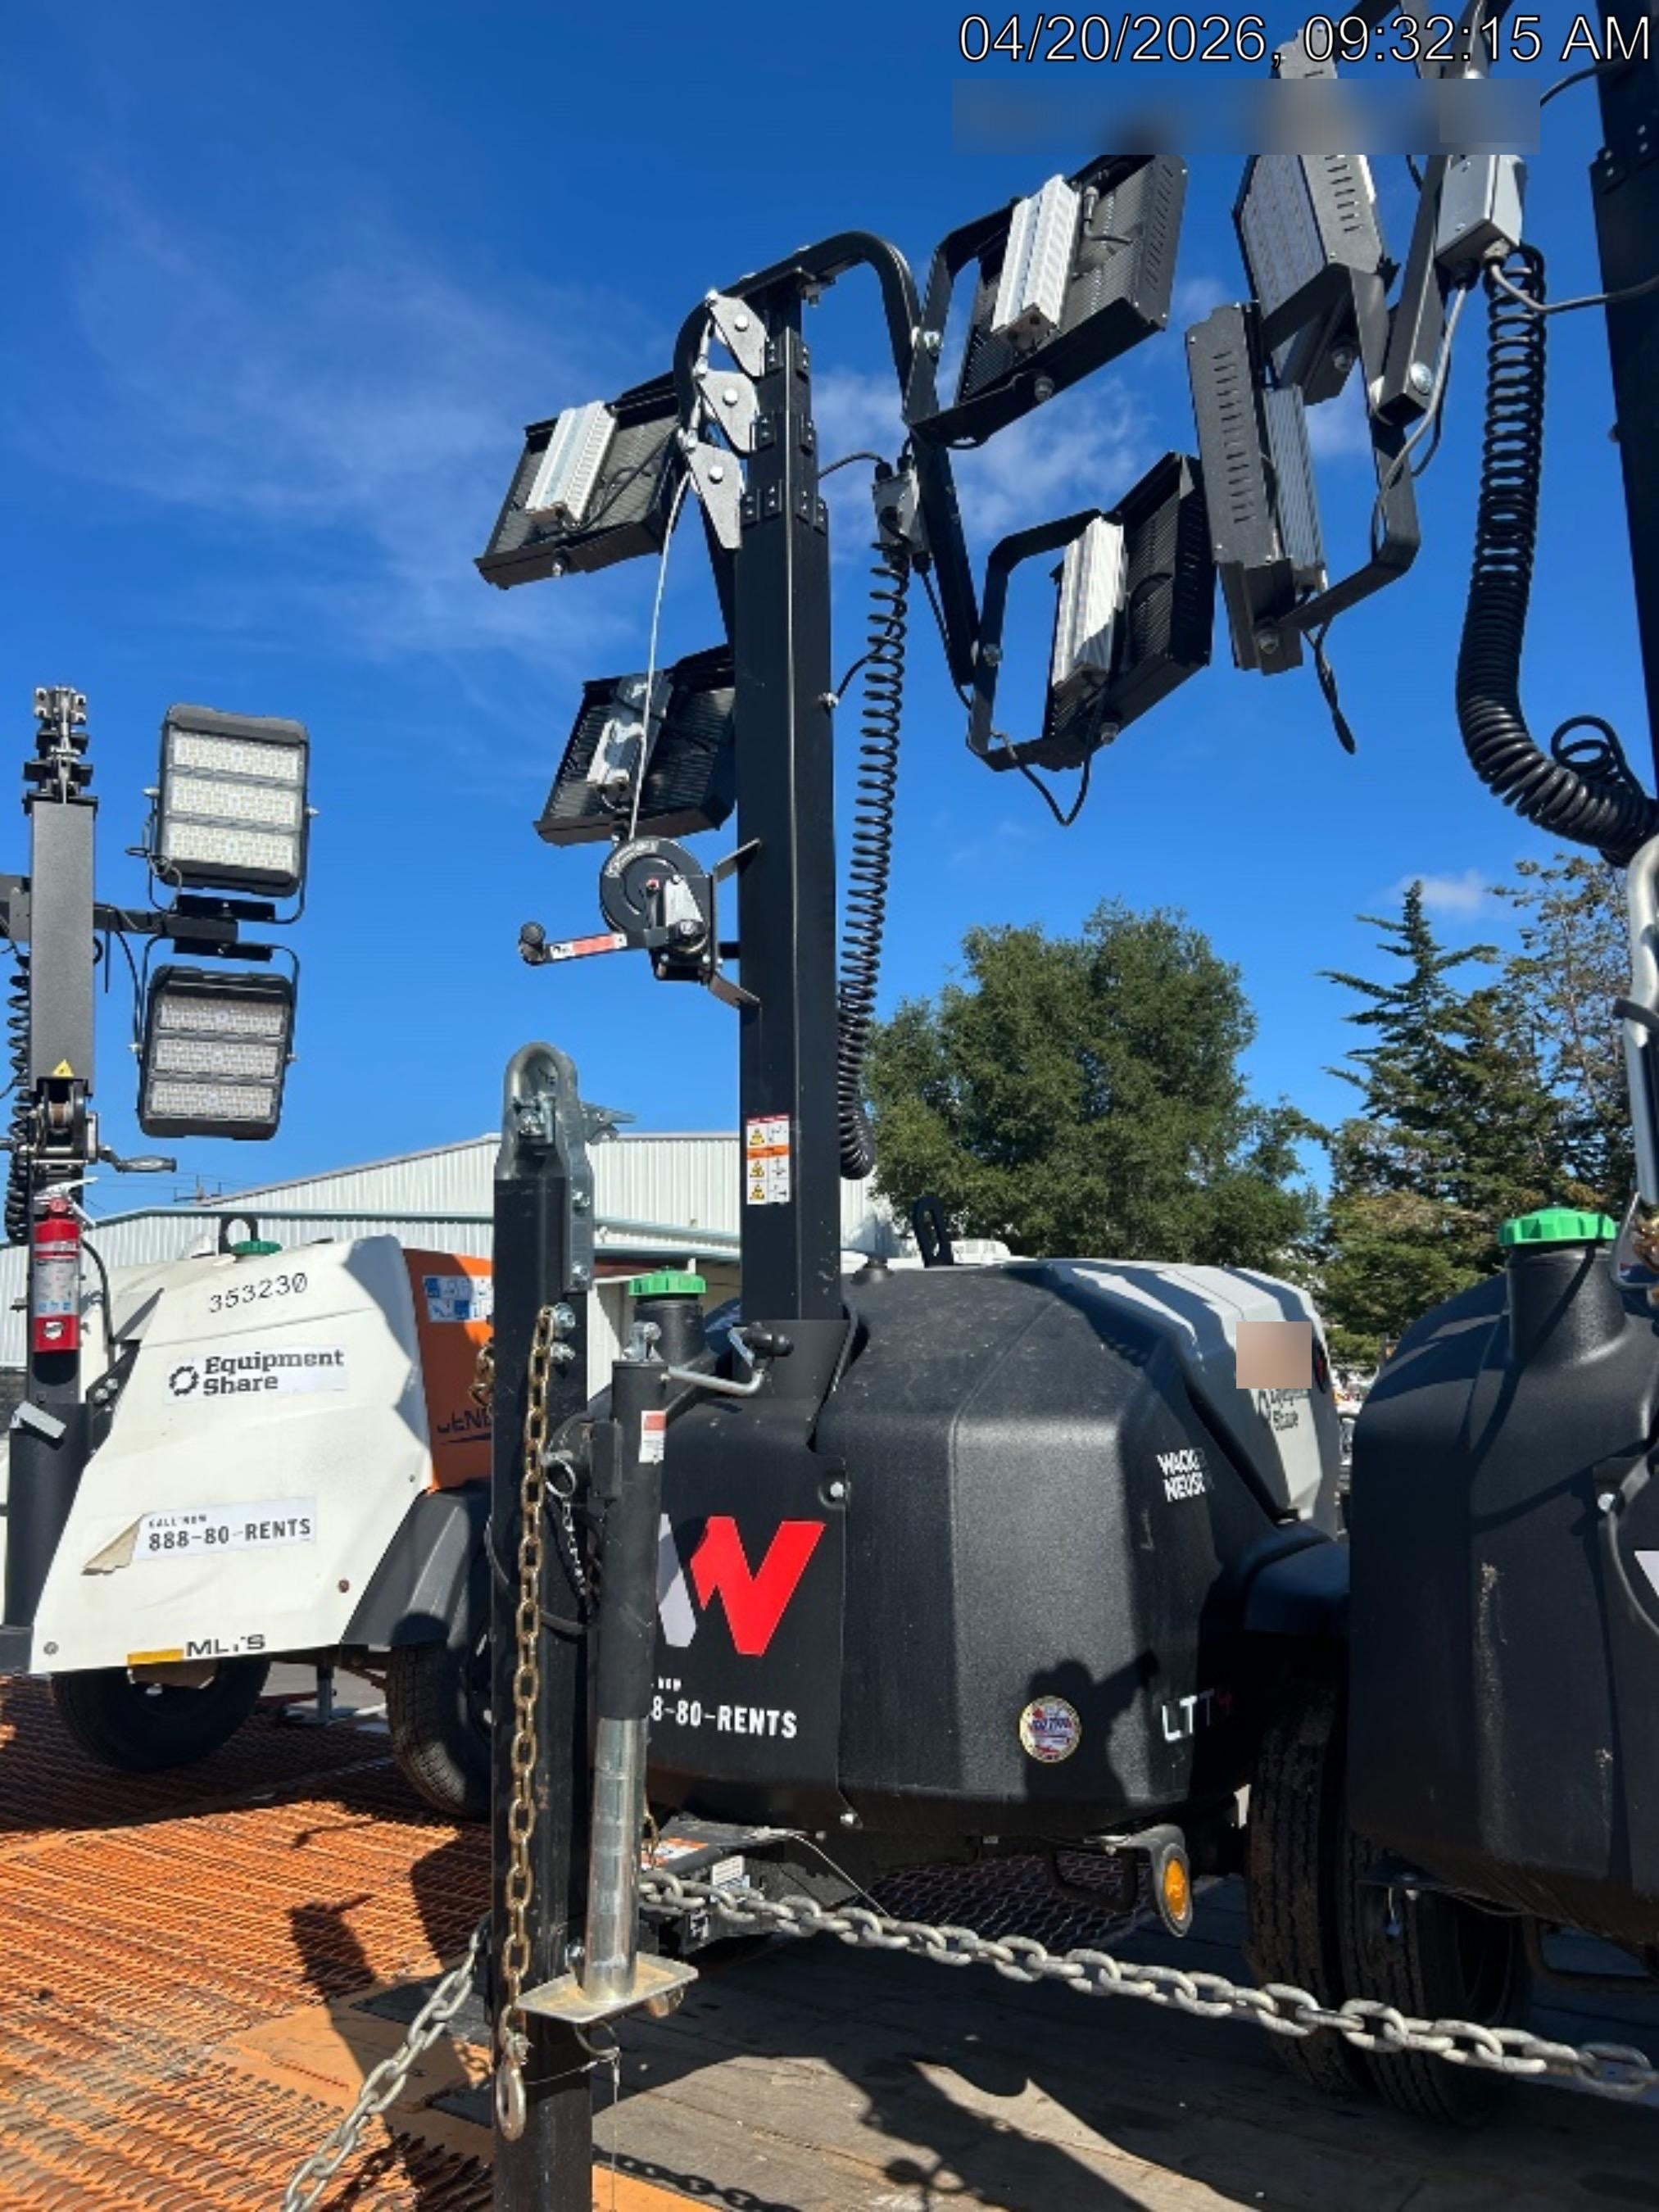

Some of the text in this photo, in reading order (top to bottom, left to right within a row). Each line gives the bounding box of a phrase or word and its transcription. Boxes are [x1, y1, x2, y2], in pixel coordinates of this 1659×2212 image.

[209, 1272, 307, 1312] 353230
[204, 1349, 344, 1376] Equipment
[203, 1376, 279, 1396] Share
[149, 1517, 310, 1551] 888-80-RENTS
[652, 1695, 797, 1738] 8-80-RENTS
